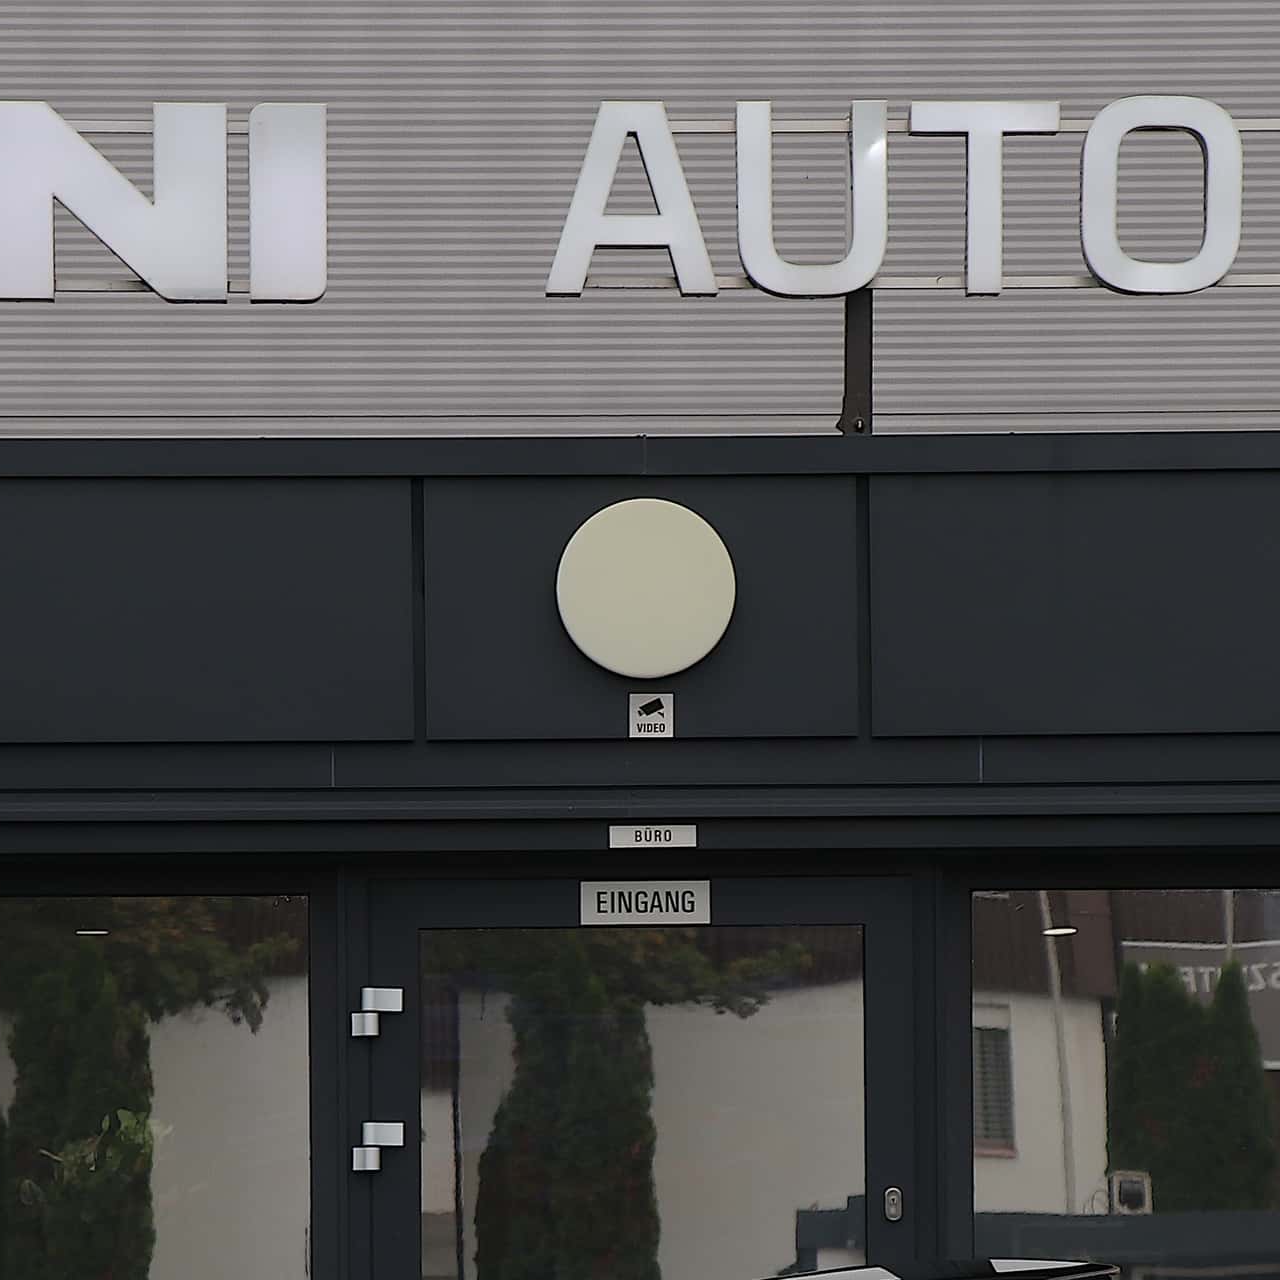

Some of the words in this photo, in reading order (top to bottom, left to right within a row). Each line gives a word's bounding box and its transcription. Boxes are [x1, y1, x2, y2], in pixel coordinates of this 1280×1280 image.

[544, 92, 1243, 297] AUTO
[636, 723, 666, 733] VIDEO
[634, 827, 673, 842] BÜRO
[596, 890, 696, 914] EINGANG
